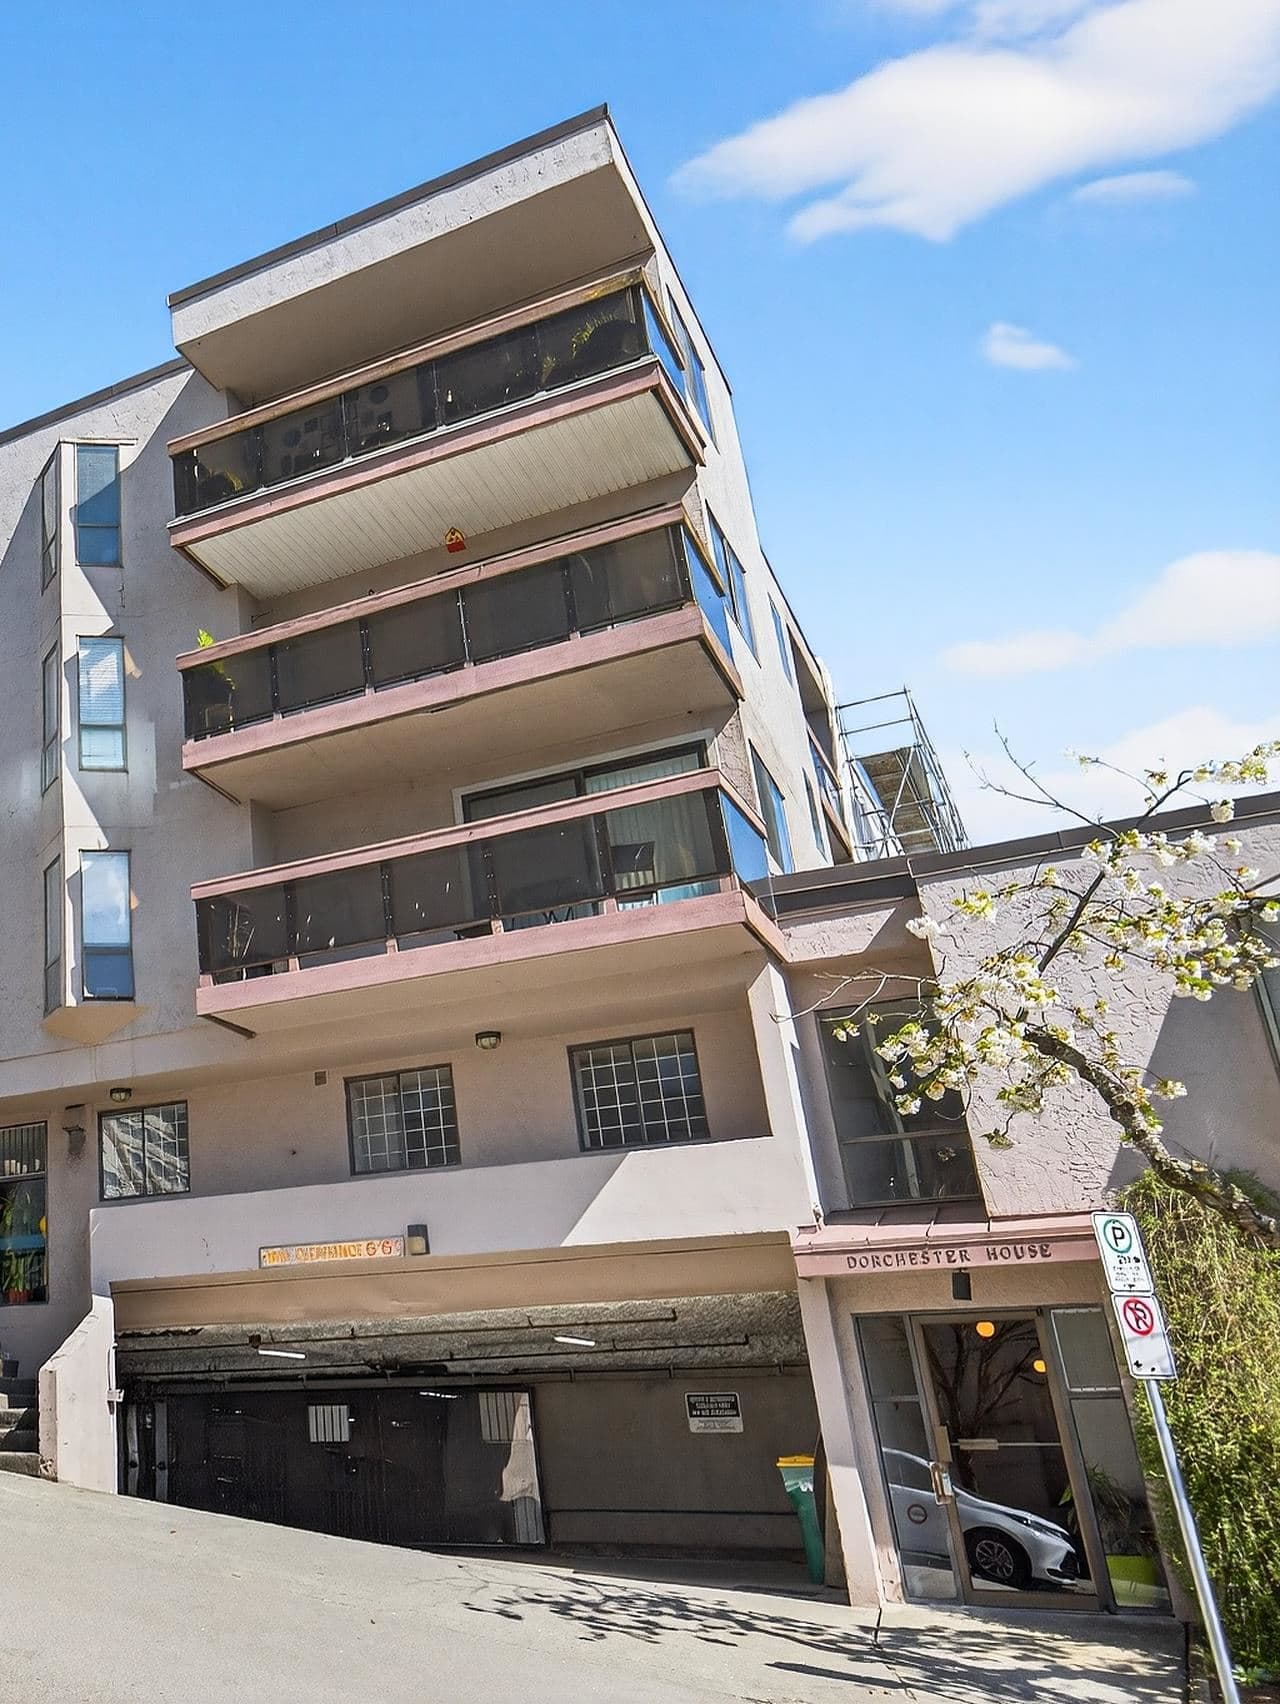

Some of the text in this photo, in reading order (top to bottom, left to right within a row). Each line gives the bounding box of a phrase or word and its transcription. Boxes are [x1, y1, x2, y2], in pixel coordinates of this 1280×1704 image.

[1111, 1226, 1125, 1247] P
[847, 1244, 1052, 1269] DORCHESTER HOUSE
